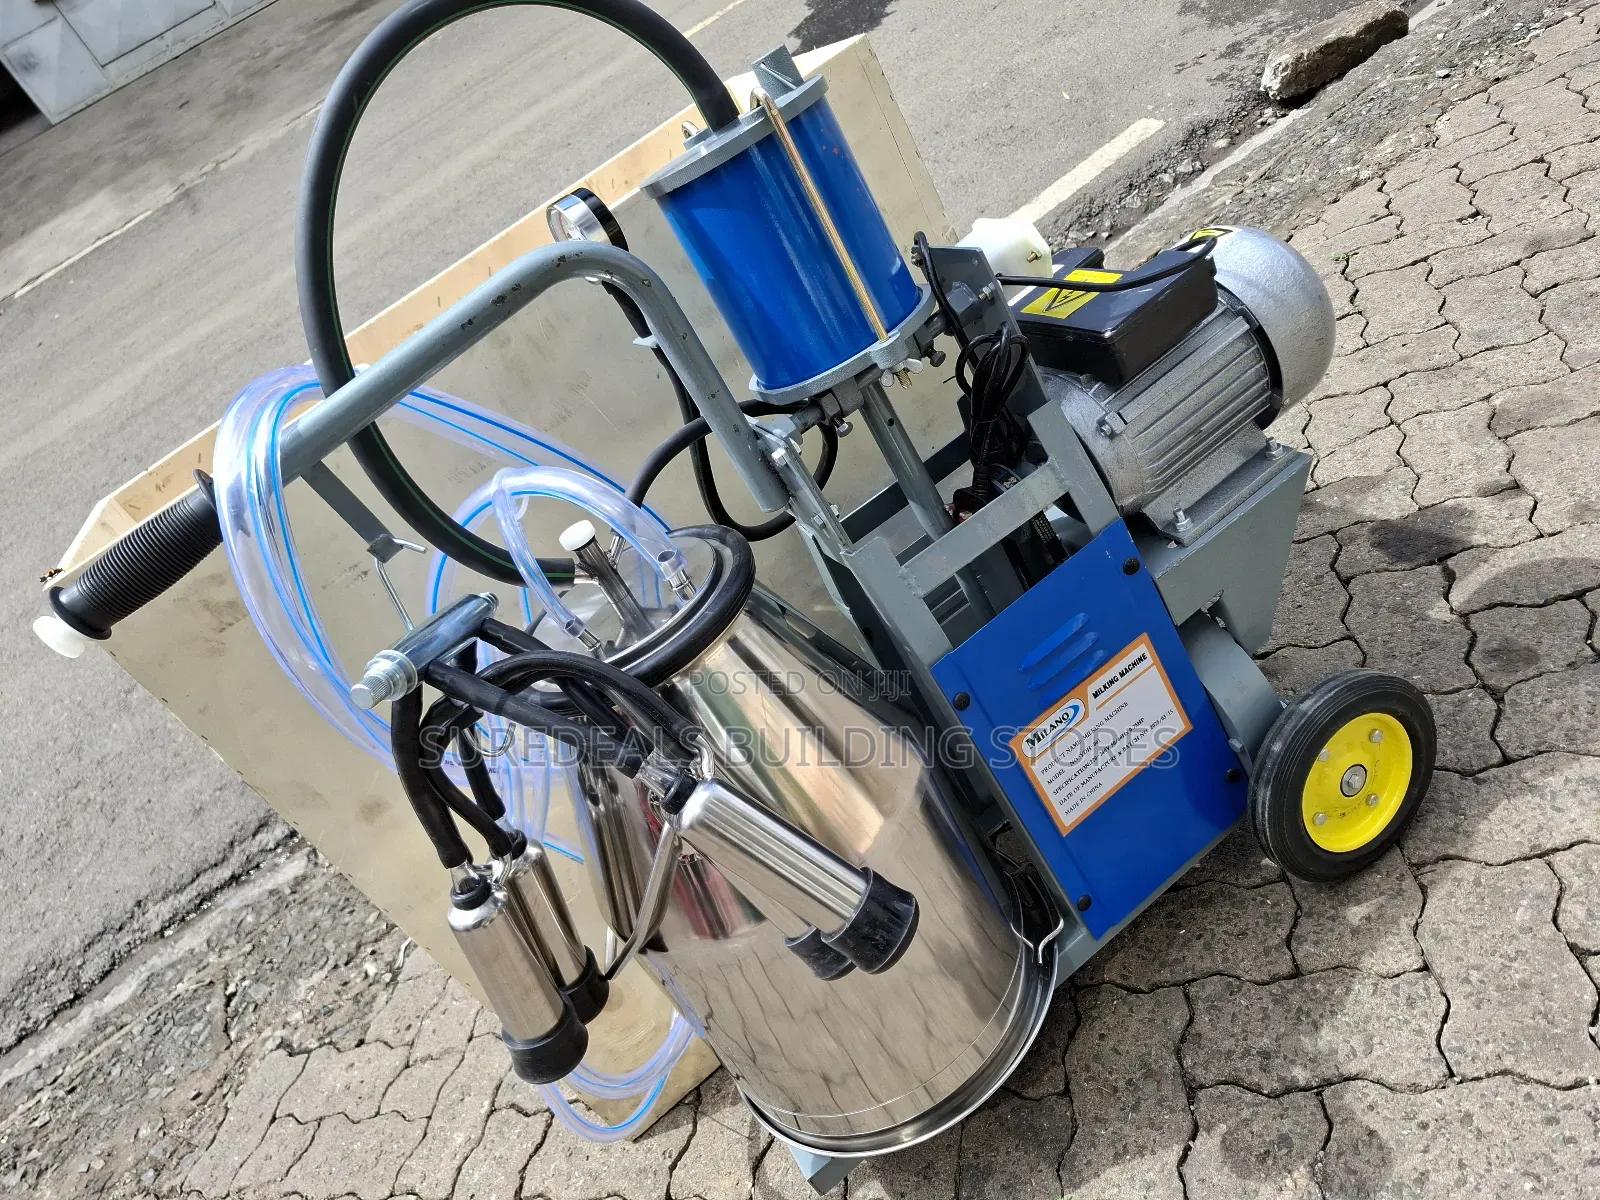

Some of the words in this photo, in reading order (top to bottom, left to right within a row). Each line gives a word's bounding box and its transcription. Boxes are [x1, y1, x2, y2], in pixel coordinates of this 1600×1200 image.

[1092, 675, 1119, 700] MILKING
[1118, 653, 1147, 678] MACHINE
[1104, 702, 1128, 723] MACHINE
[1046, 769, 1065, 785] MODEL
[1058, 791, 1073, 806] DATE
[1072, 785, 1081, 794] OF
[1079, 755, 1117, 787] MANUFACTURE
[1122, 735, 1140, 752] BATCH
[1065, 801, 1080, 815] MADE
[1079, 795, 1086, 803] IN
[1086, 782, 1102, 797] CHINA
